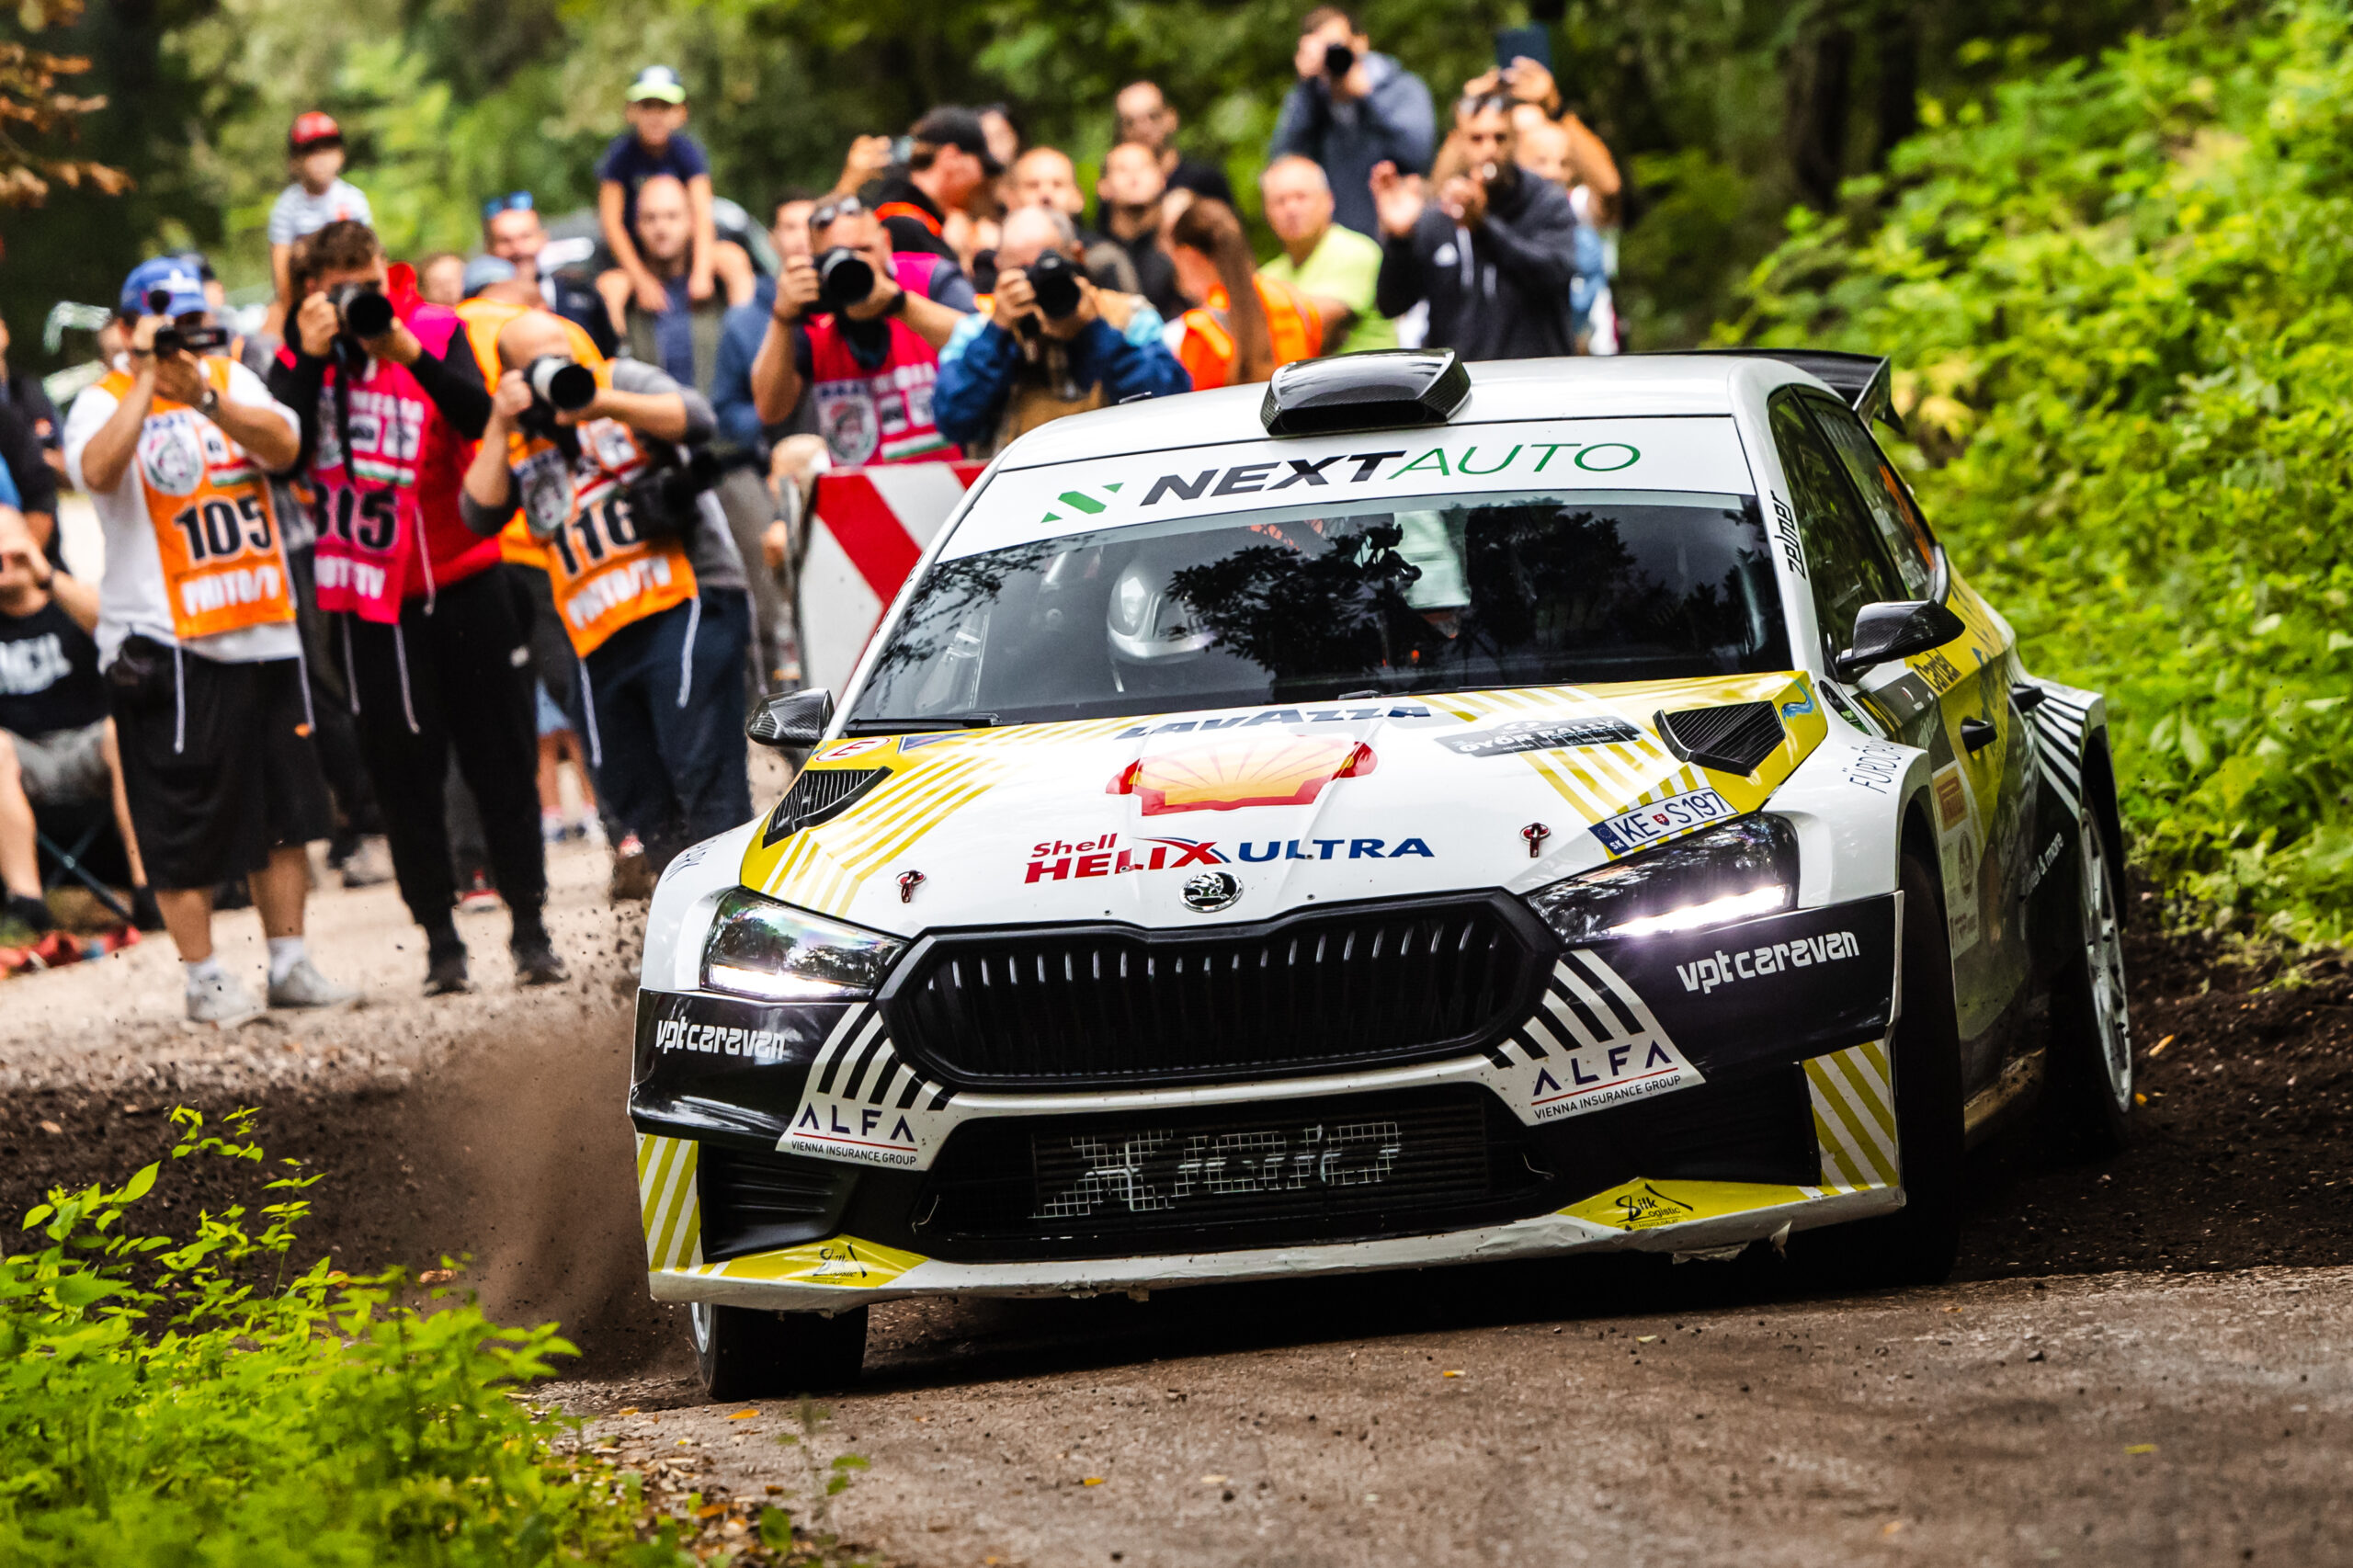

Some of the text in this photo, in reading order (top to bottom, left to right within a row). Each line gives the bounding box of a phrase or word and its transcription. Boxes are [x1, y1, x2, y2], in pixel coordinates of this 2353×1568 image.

[173, 493, 273, 562] 105
[1770, 488, 1807, 581] zelmer
[1538, 720, 1621, 740] RALLY
[1613, 791, 1727, 843] KE S197
[1023, 836, 1436, 885] HELIX ULTRA
[1031, 832, 1119, 858] Shell
[1609, 839, 1624, 850] SK
[1533, 1039, 1673, 1097] ALFA
[1533, 1074, 1682, 1120] VIENNA INSURANCE GROUP
[798, 1101, 915, 1143] ALFA
[791, 1140, 917, 1166] VIENNA INSURANCE GROUP
